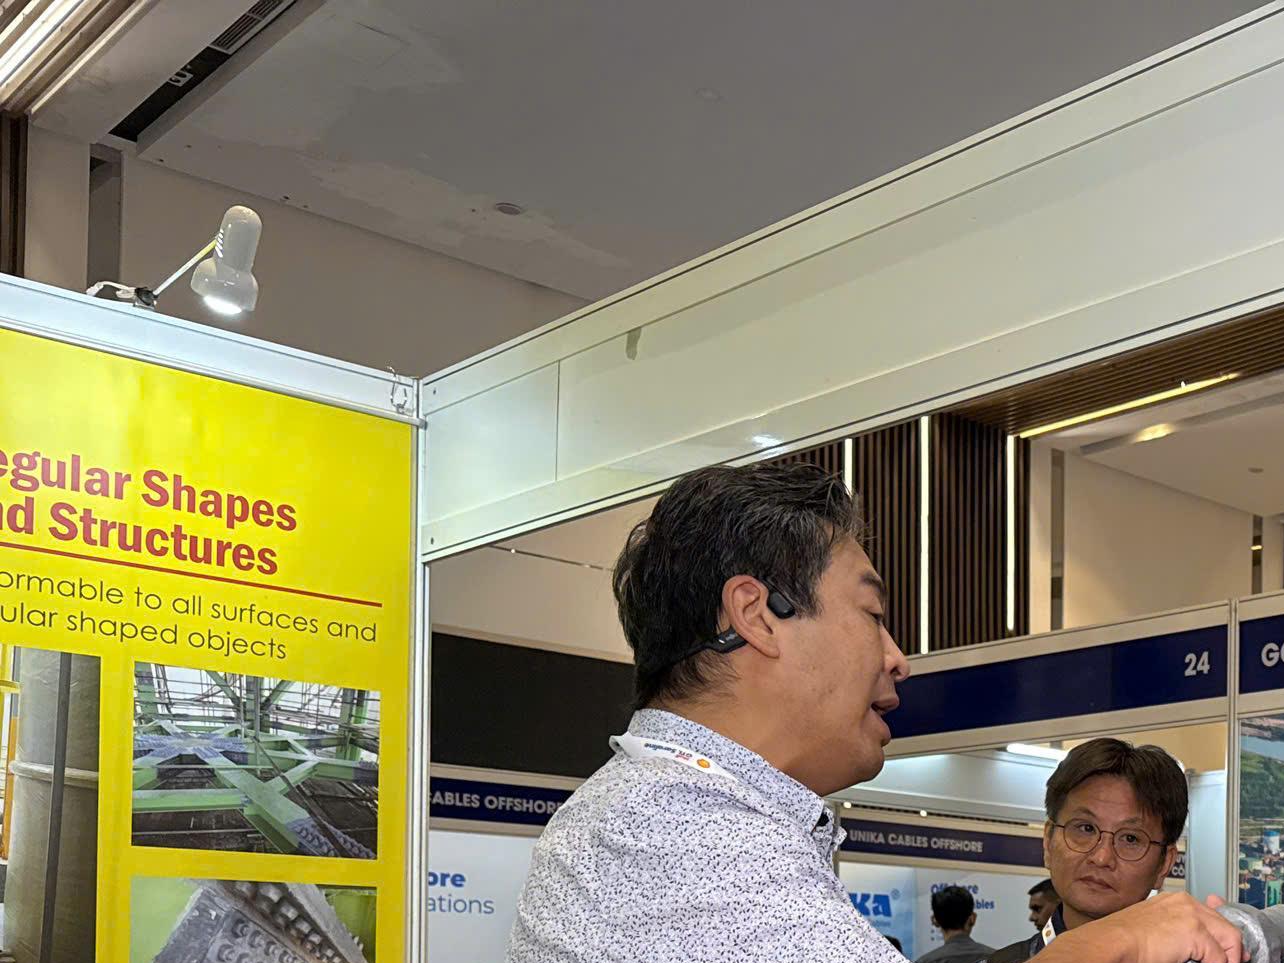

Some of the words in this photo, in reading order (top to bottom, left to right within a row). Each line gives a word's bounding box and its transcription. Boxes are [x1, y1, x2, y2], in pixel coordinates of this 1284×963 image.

[141, 469, 297, 531] Shapes
[48, 501, 279, 576] Structures
[0, 602, 58, 628] ular
[67, 610, 178, 645] shaped
[188, 628, 287, 660] objects
[134, 586, 163, 610] to
[172, 595, 202, 617] all
[211, 603, 319, 634] surfaces
[326, 622, 376, 643] and
[1184, 650, 1211, 677] 24
[428, 790, 480, 808] ABLES
[849, 829, 885, 844] UNIKA
[888, 834, 928, 848] CABLES
[931, 838, 983, 853] OFFSHORE
[975, 898, 994, 909] bles
